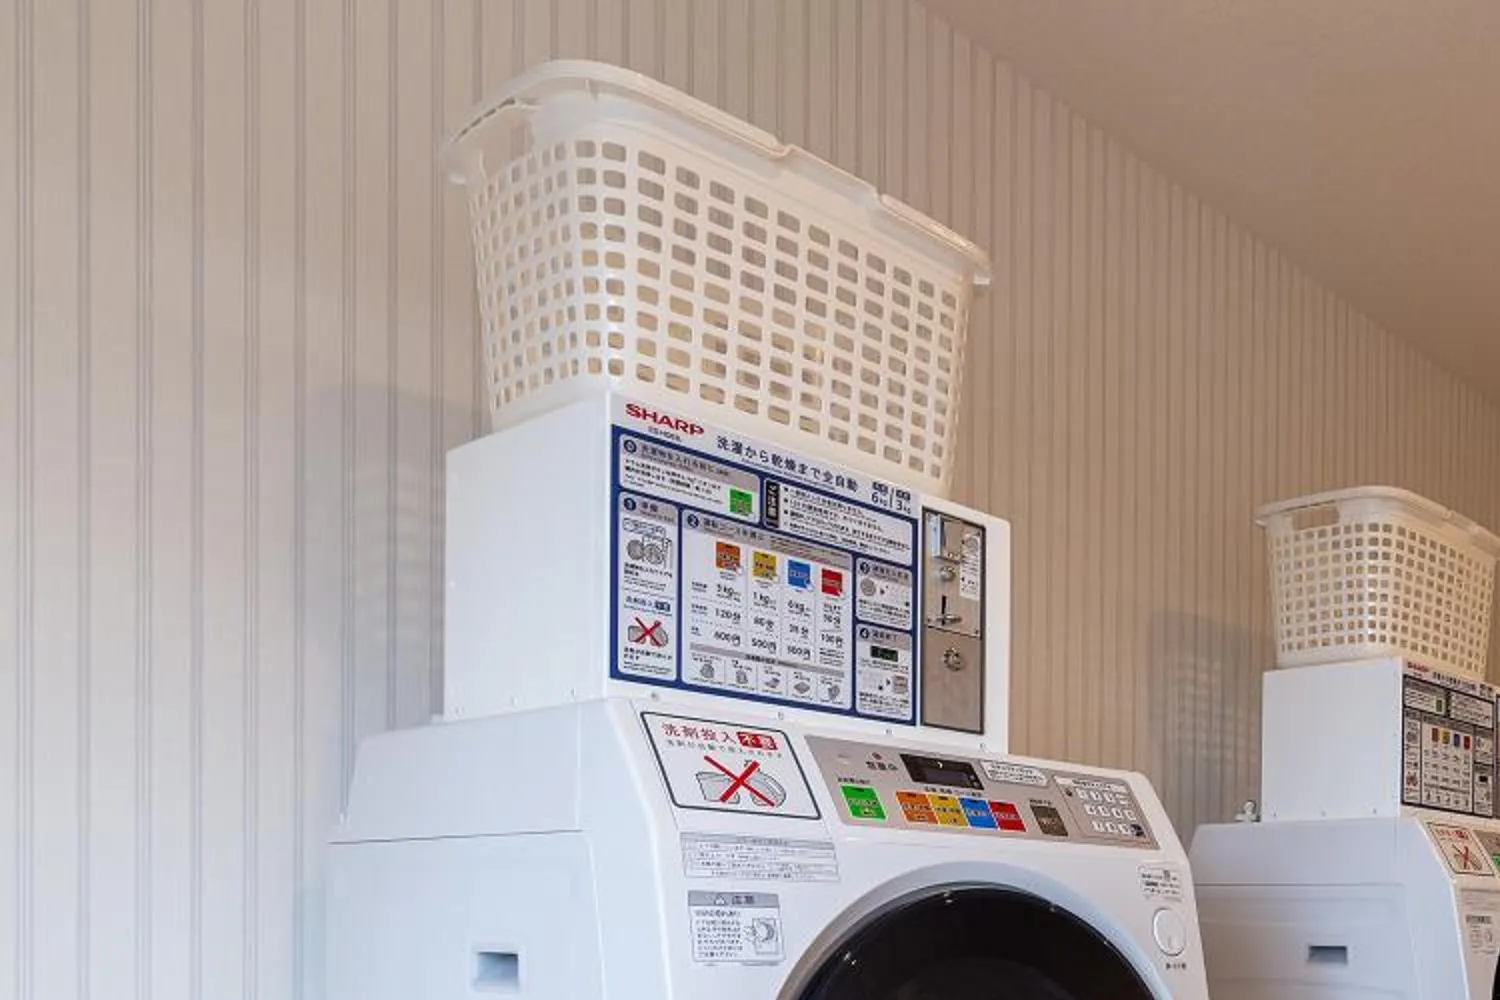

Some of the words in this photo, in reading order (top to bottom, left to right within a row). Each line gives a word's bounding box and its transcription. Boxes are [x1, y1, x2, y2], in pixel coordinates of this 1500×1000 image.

[625, 403, 704, 436] SHARP
[717, 435, 859, 493] 洗濯から乾燥まで全自動
